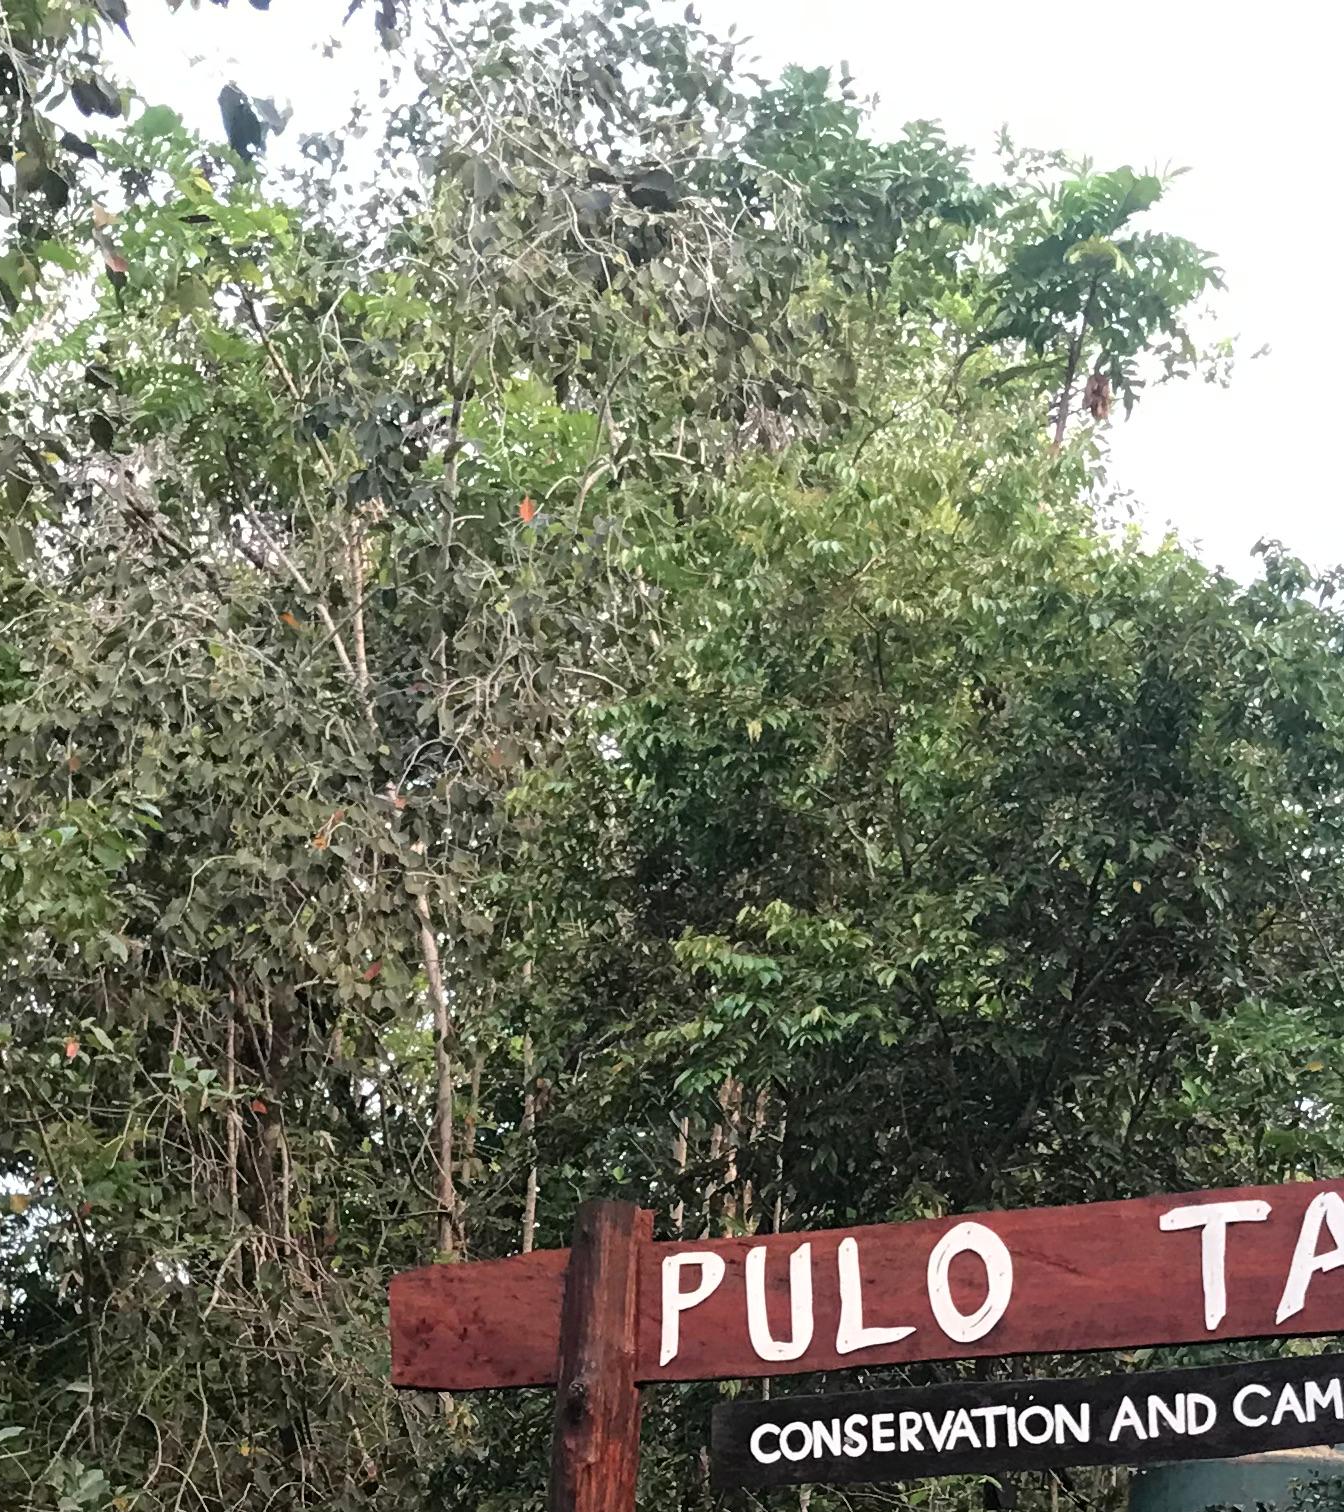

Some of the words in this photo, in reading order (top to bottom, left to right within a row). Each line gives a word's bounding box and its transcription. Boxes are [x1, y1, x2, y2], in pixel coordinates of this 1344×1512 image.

[659, 1221, 1014, 1367] PULO
[750, 1403, 1091, 1464] CONSERVATION
[1109, 1392, 1218, 1442] AND
